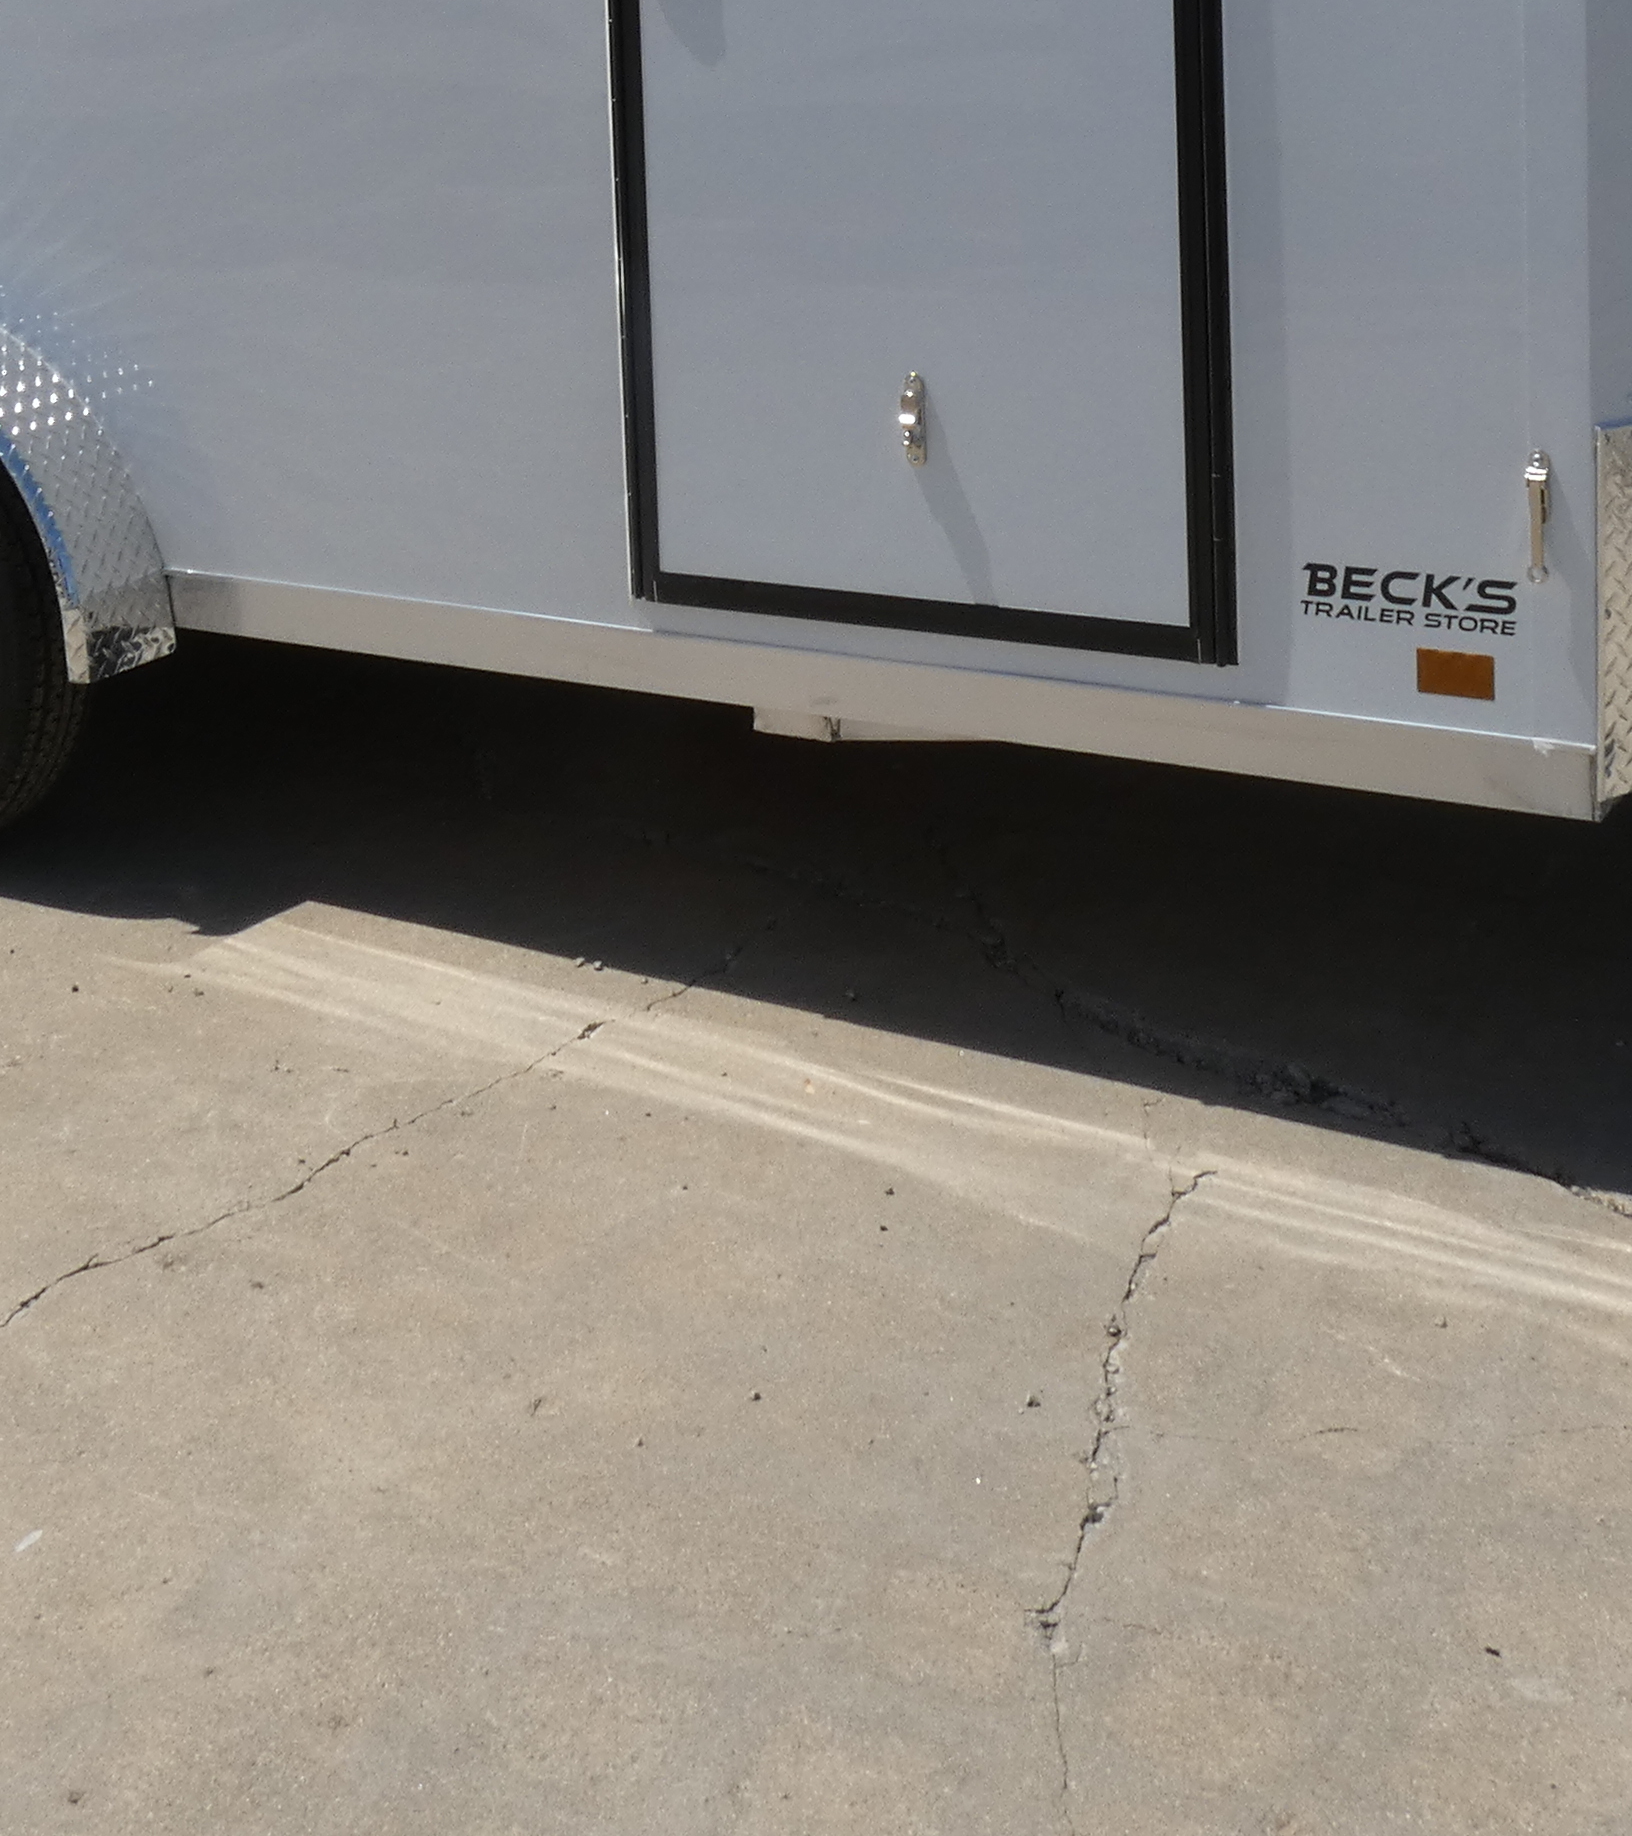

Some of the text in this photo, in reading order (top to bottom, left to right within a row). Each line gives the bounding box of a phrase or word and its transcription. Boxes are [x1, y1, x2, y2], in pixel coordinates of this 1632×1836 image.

[1302, 562, 1518, 615] BECK'S
[1300, 600, 1517, 636] TRAILER STORE
